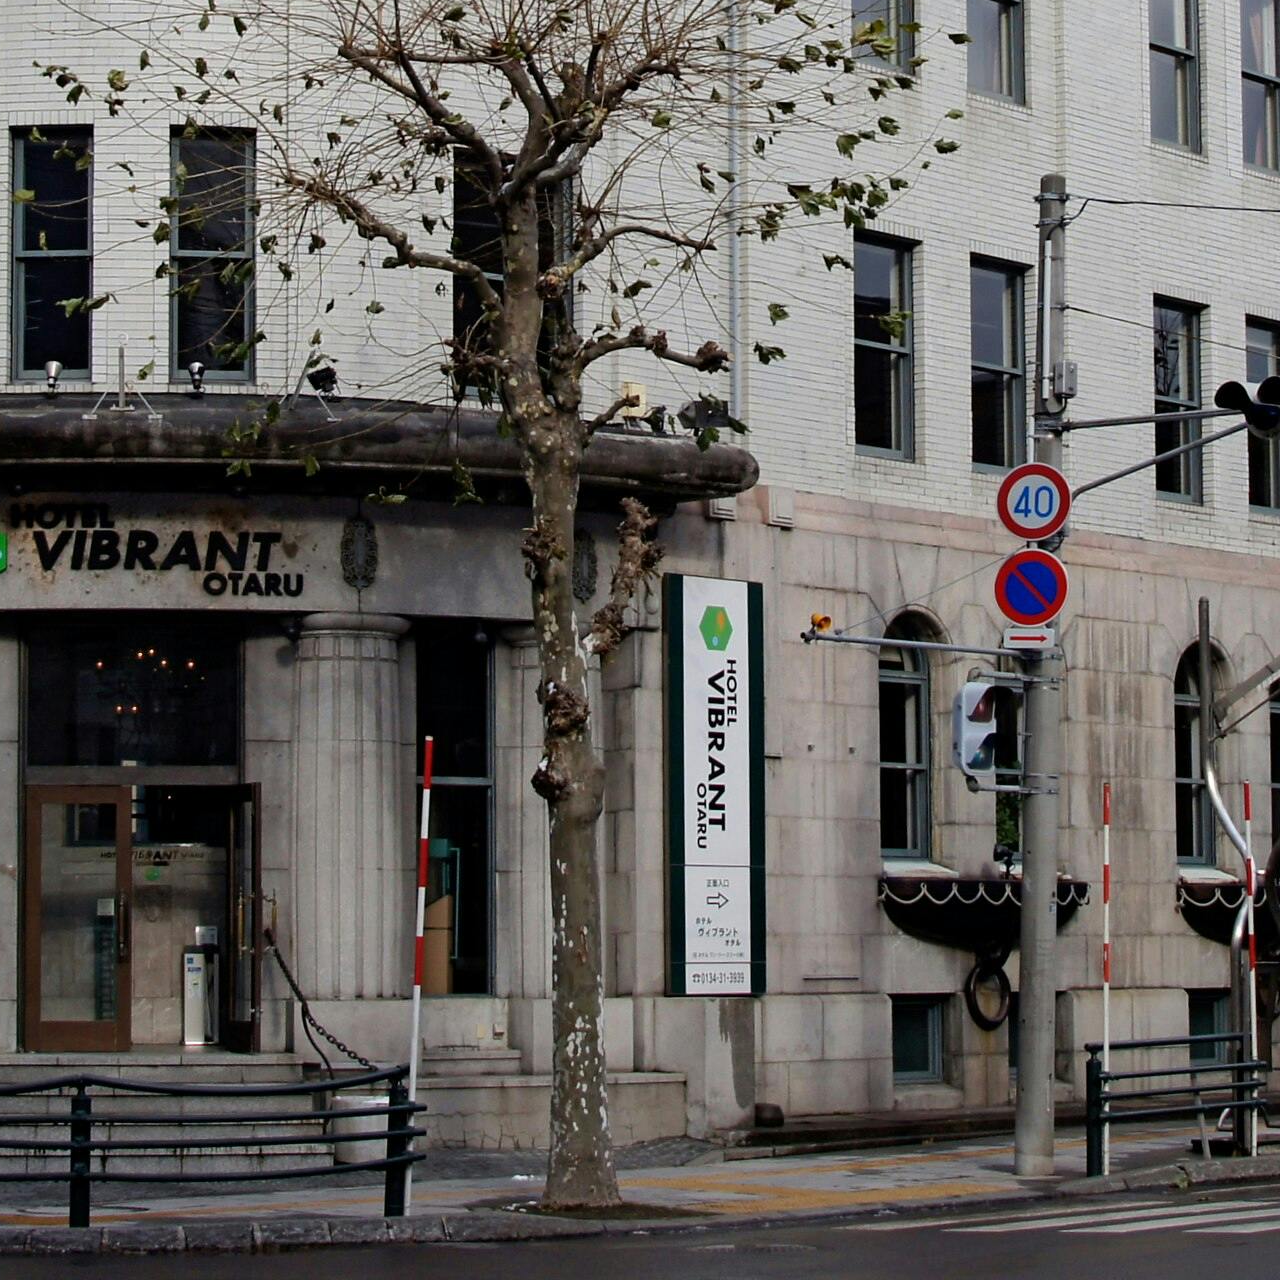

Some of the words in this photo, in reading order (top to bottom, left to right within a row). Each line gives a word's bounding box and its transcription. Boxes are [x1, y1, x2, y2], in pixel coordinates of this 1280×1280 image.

[10, 504, 115, 529] HOTEL
[1014, 486, 1053, 518] 40
[33, 530, 282, 572] VIBRANT
[203, 573, 304, 597] OTARU
[726, 659, 737, 727] HOTEL
[708, 669, 726, 831] VIBRANT
[697, 782, 707, 849] OTARU
